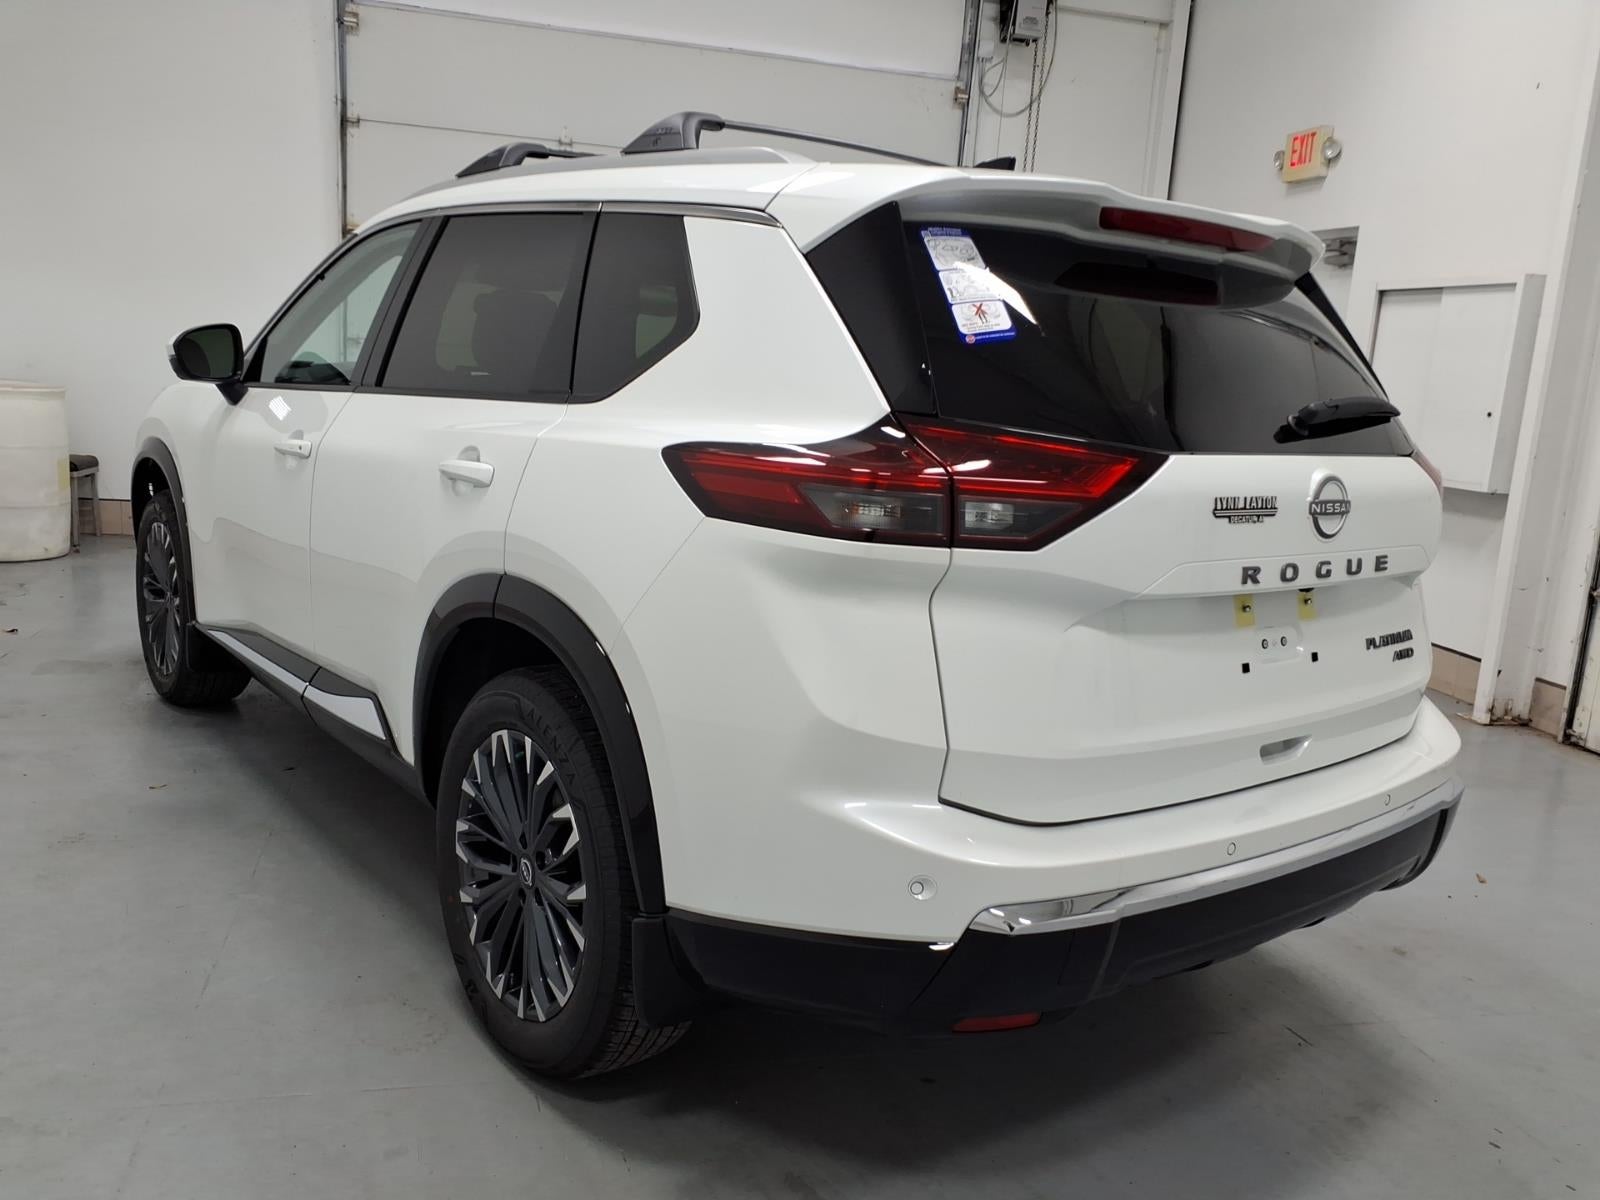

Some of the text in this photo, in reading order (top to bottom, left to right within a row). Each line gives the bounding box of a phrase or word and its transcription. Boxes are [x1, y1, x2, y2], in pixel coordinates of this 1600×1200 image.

[1290, 131, 1317, 167] EXIT
[1214, 495, 1278, 510] LYNN LAYTON
[1311, 502, 1351, 514] NISSAN
[1241, 554, 1389, 585] ROGUE
